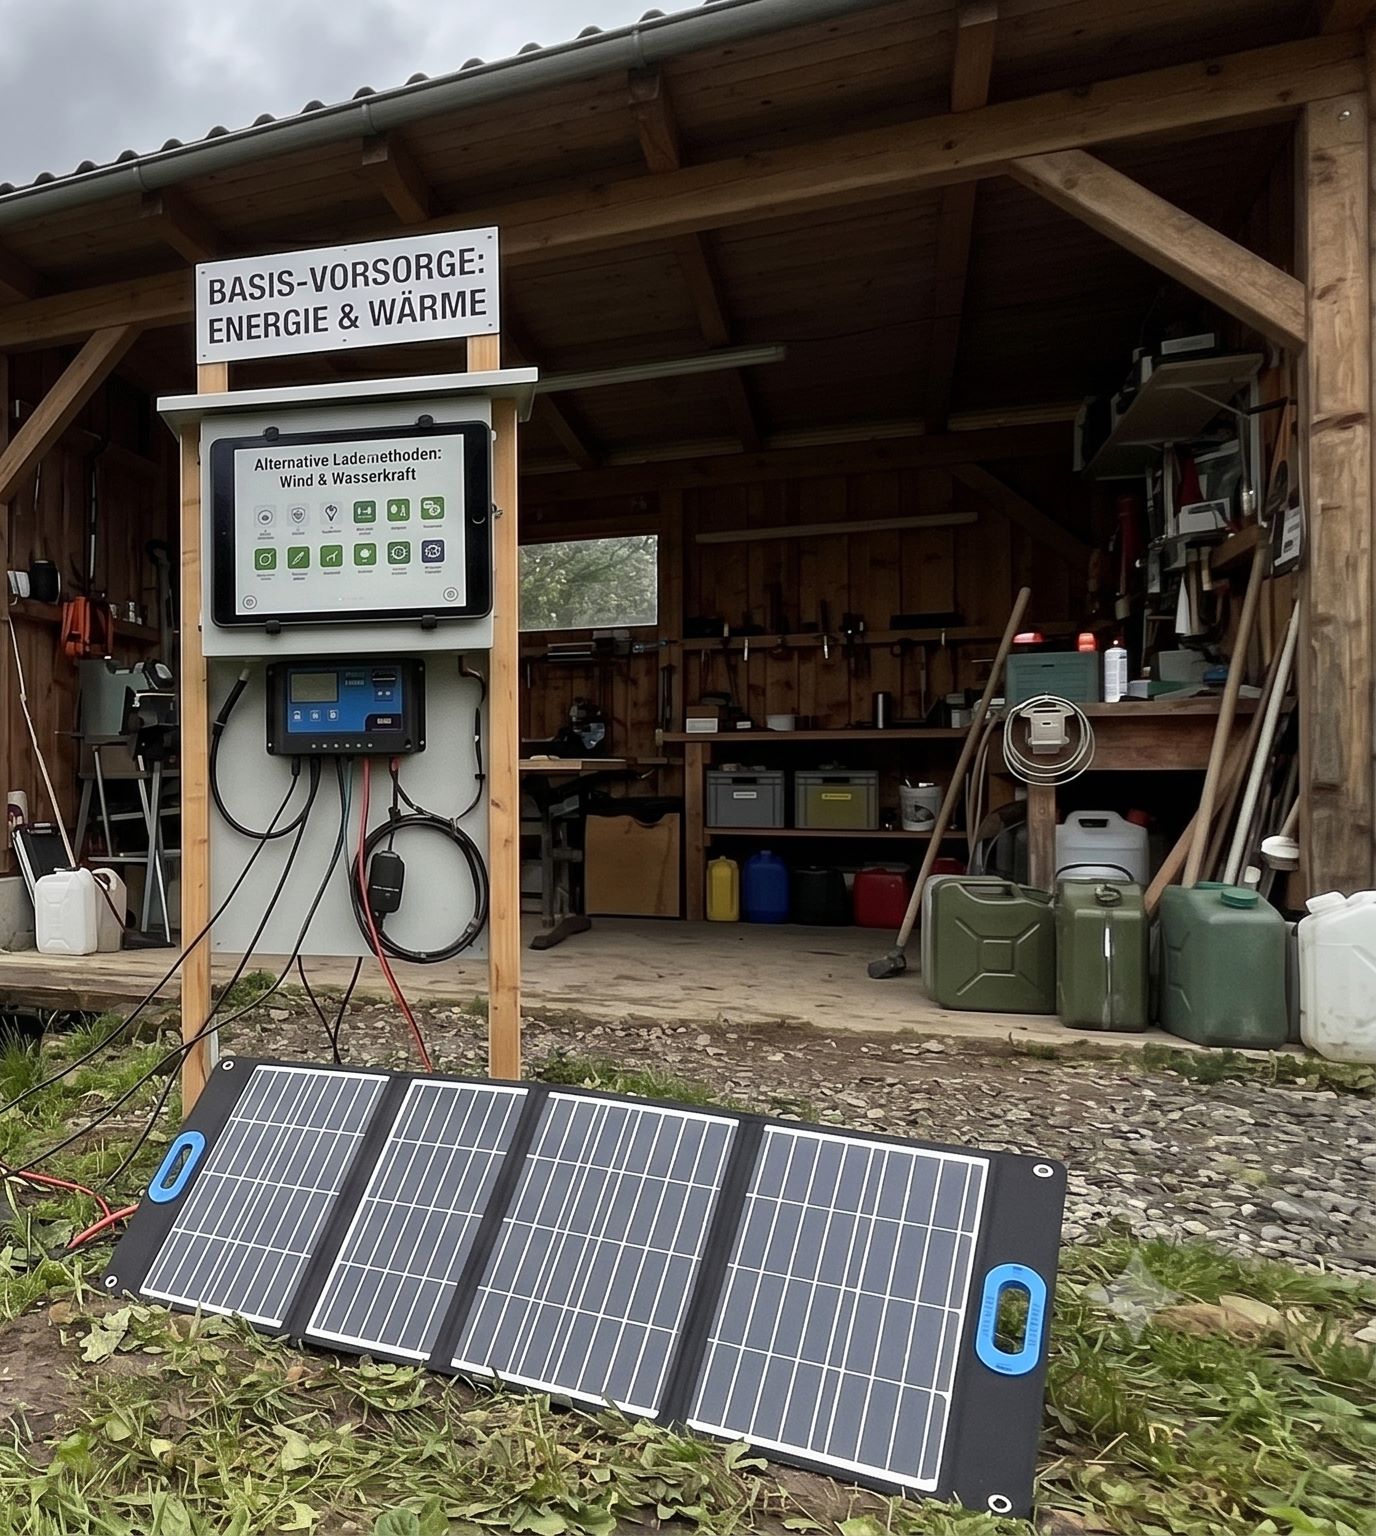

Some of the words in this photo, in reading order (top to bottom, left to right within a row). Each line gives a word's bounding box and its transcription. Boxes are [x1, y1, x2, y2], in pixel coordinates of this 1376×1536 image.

[208, 247, 485, 305] BASIS-VORSORGE:
[208, 306, 329, 344] ENERGIE
[338, 303, 360, 331] &
[369, 288, 487, 327] WÄRME
[254, 453, 329, 472] Alternative
[333, 447, 442, 467] Lademethoden:
[279, 472, 314, 488] Wind
[318, 470, 328, 486] &
[332, 467, 416, 485] Wasserkraft
